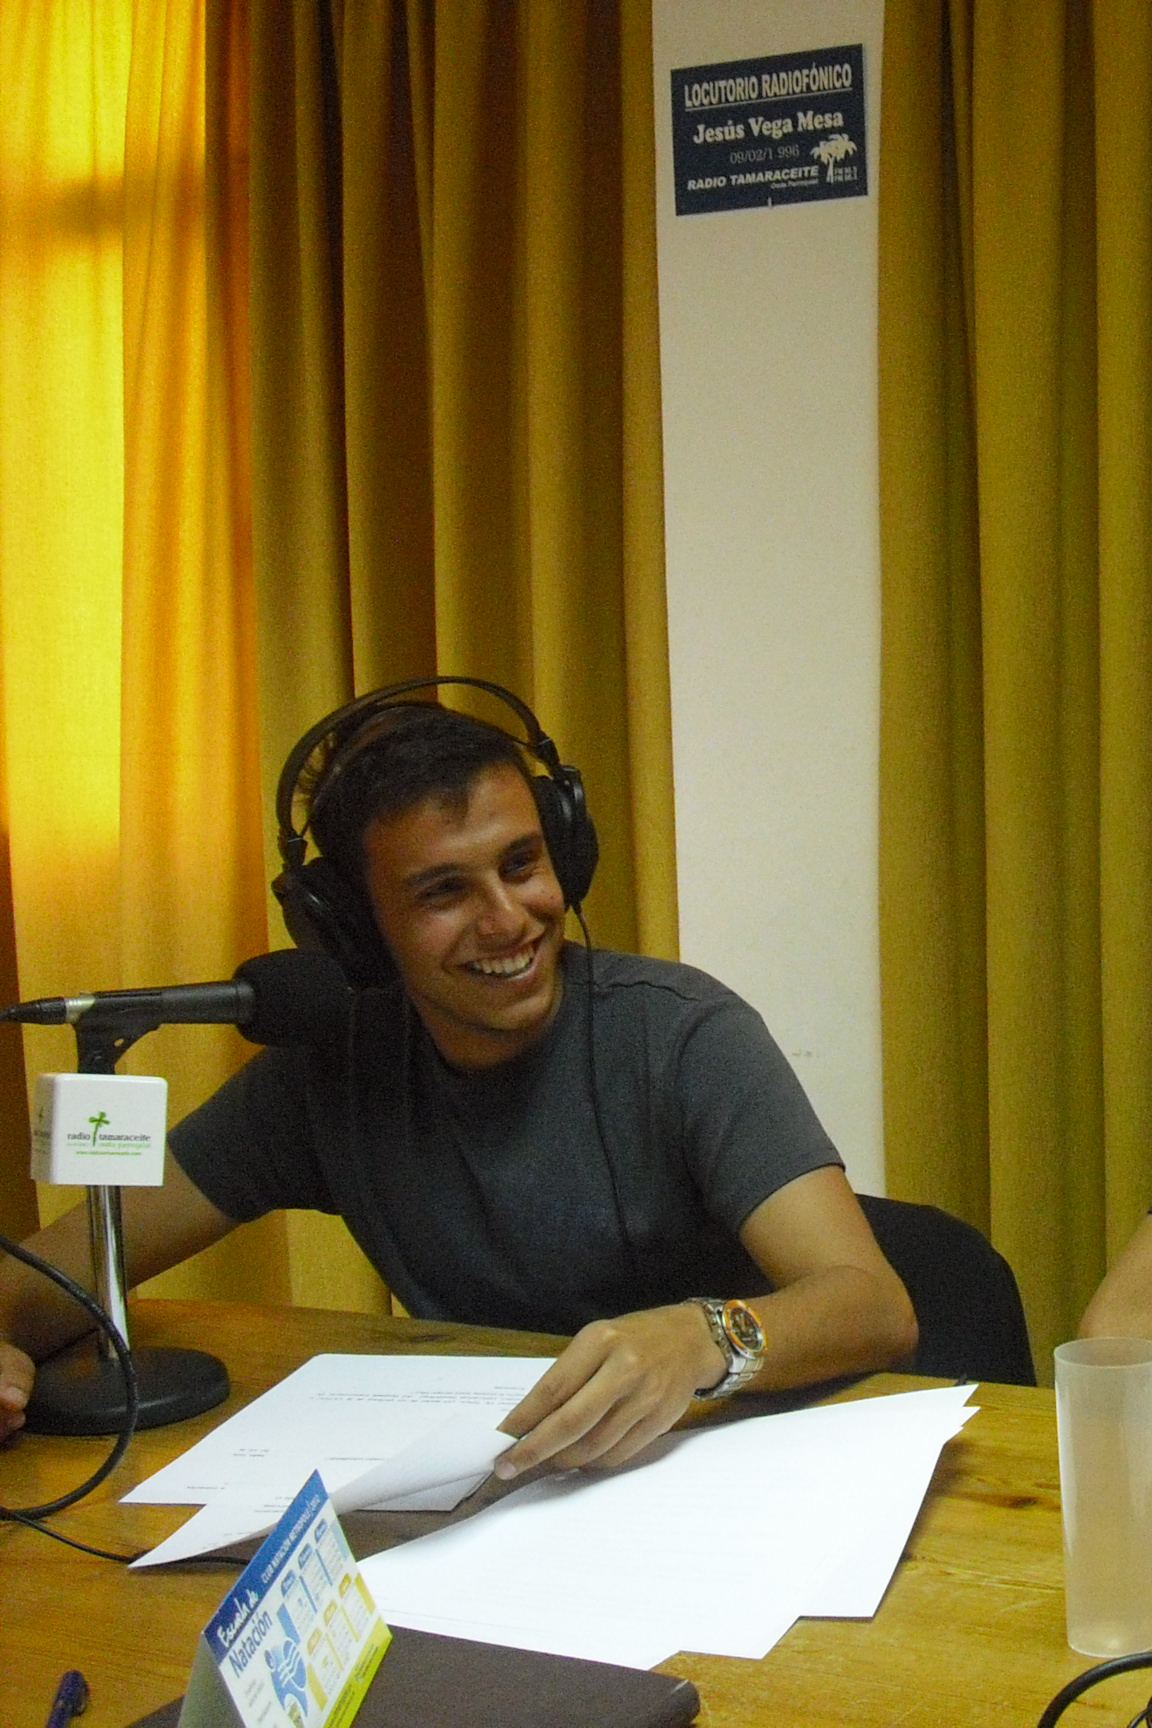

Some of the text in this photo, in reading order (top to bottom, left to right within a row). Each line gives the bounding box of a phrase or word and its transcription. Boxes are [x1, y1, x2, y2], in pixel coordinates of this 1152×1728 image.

[685, 62, 852, 107] LOCUTORIO RADIOFÓNICO
[693, 110, 844, 144] Jesús Vega Mesa
[687, 176, 727, 190] RADIO
[730, 165, 819, 186] TAMARACEITE
[67, 1132, 152, 1142] radio tamaraceite
[229, 1609, 273, 1679] Natación
